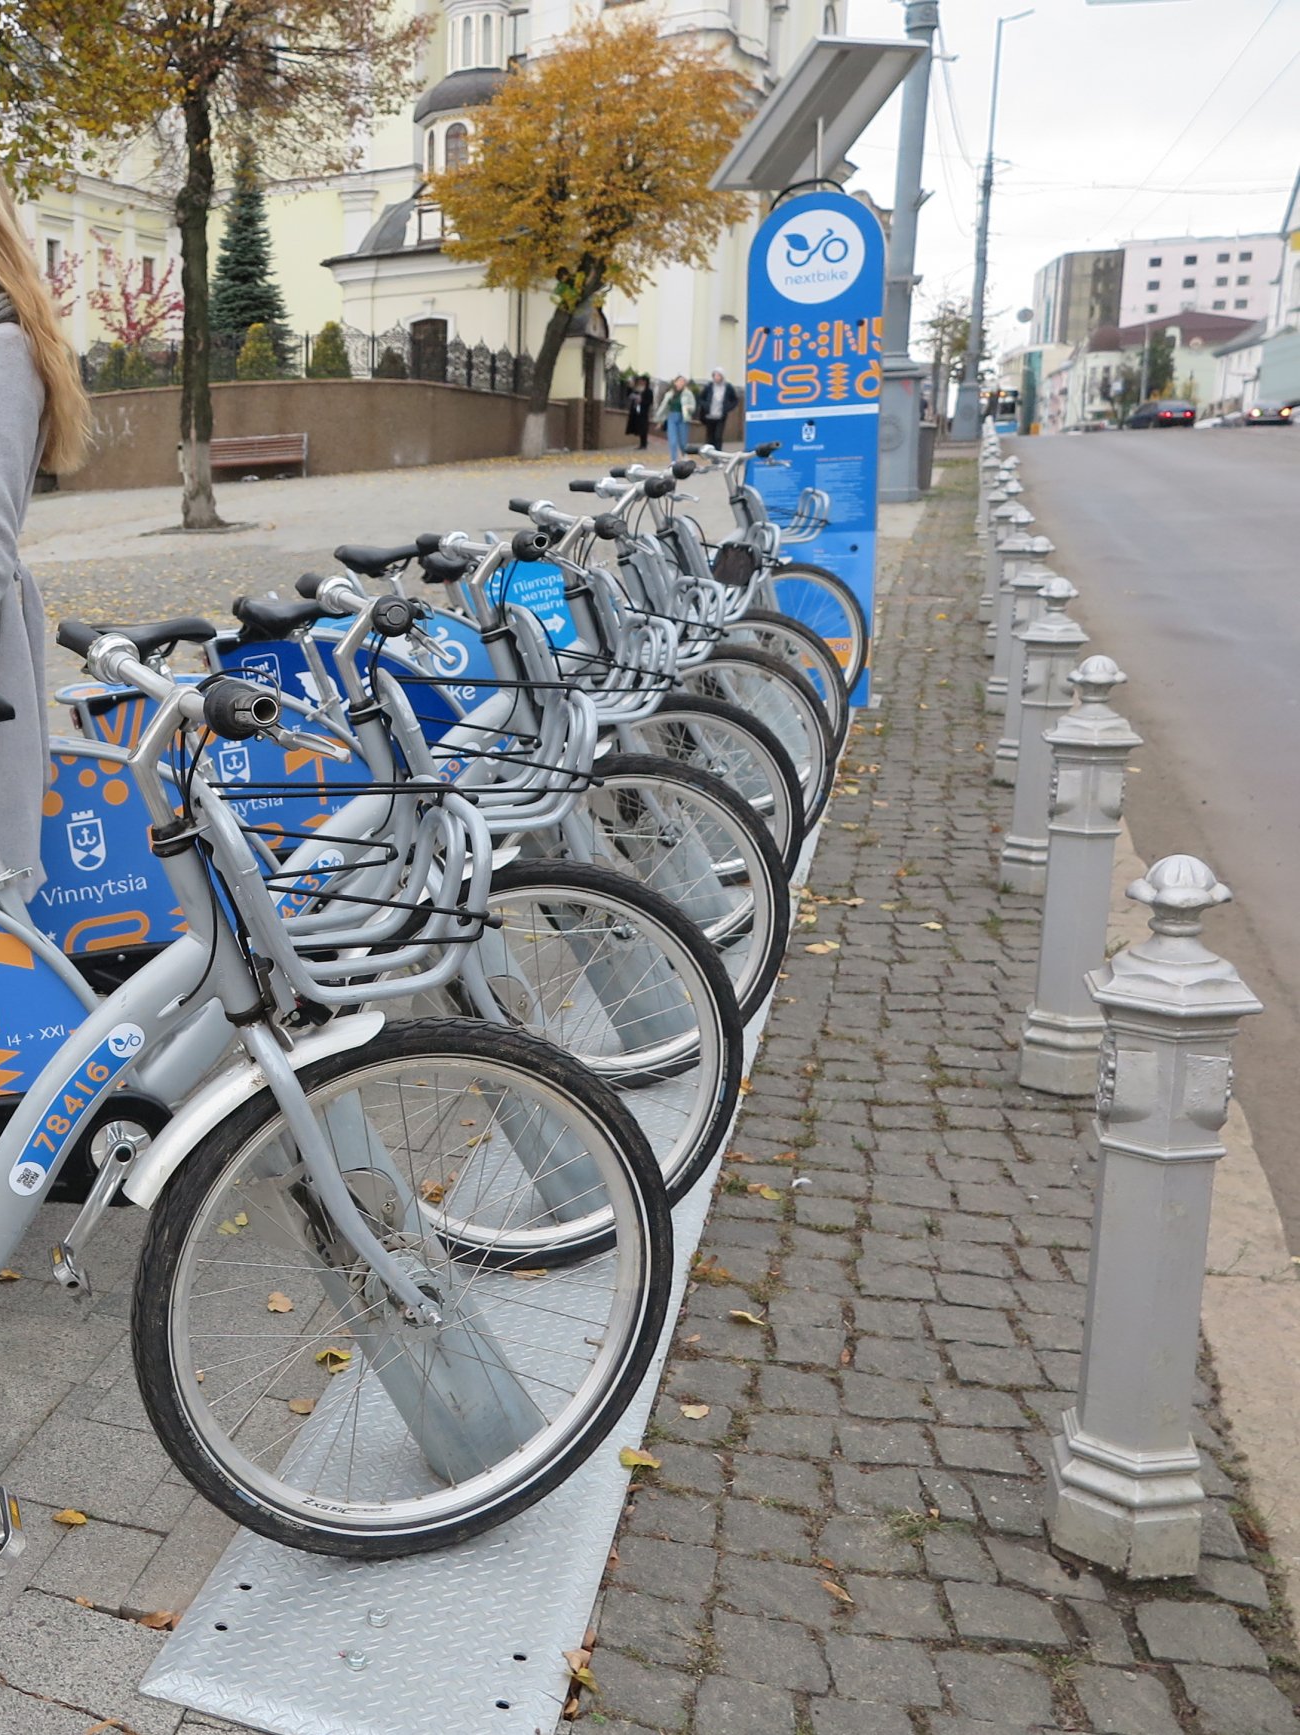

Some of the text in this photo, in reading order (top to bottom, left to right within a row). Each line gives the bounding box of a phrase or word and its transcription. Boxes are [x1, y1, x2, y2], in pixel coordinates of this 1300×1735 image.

[784, 268, 849, 287] nextbike
[513, 573, 564, 594] Півтора
[521, 587, 560, 604] метра
[530, 599, 564, 613] оваги
[230, 792, 284, 817] nytsia
[40, 873, 148, 907] Vinnytsia
[38, 1024, 65, 1041] XXI
[32, 1061, 110, 1153] 78416
